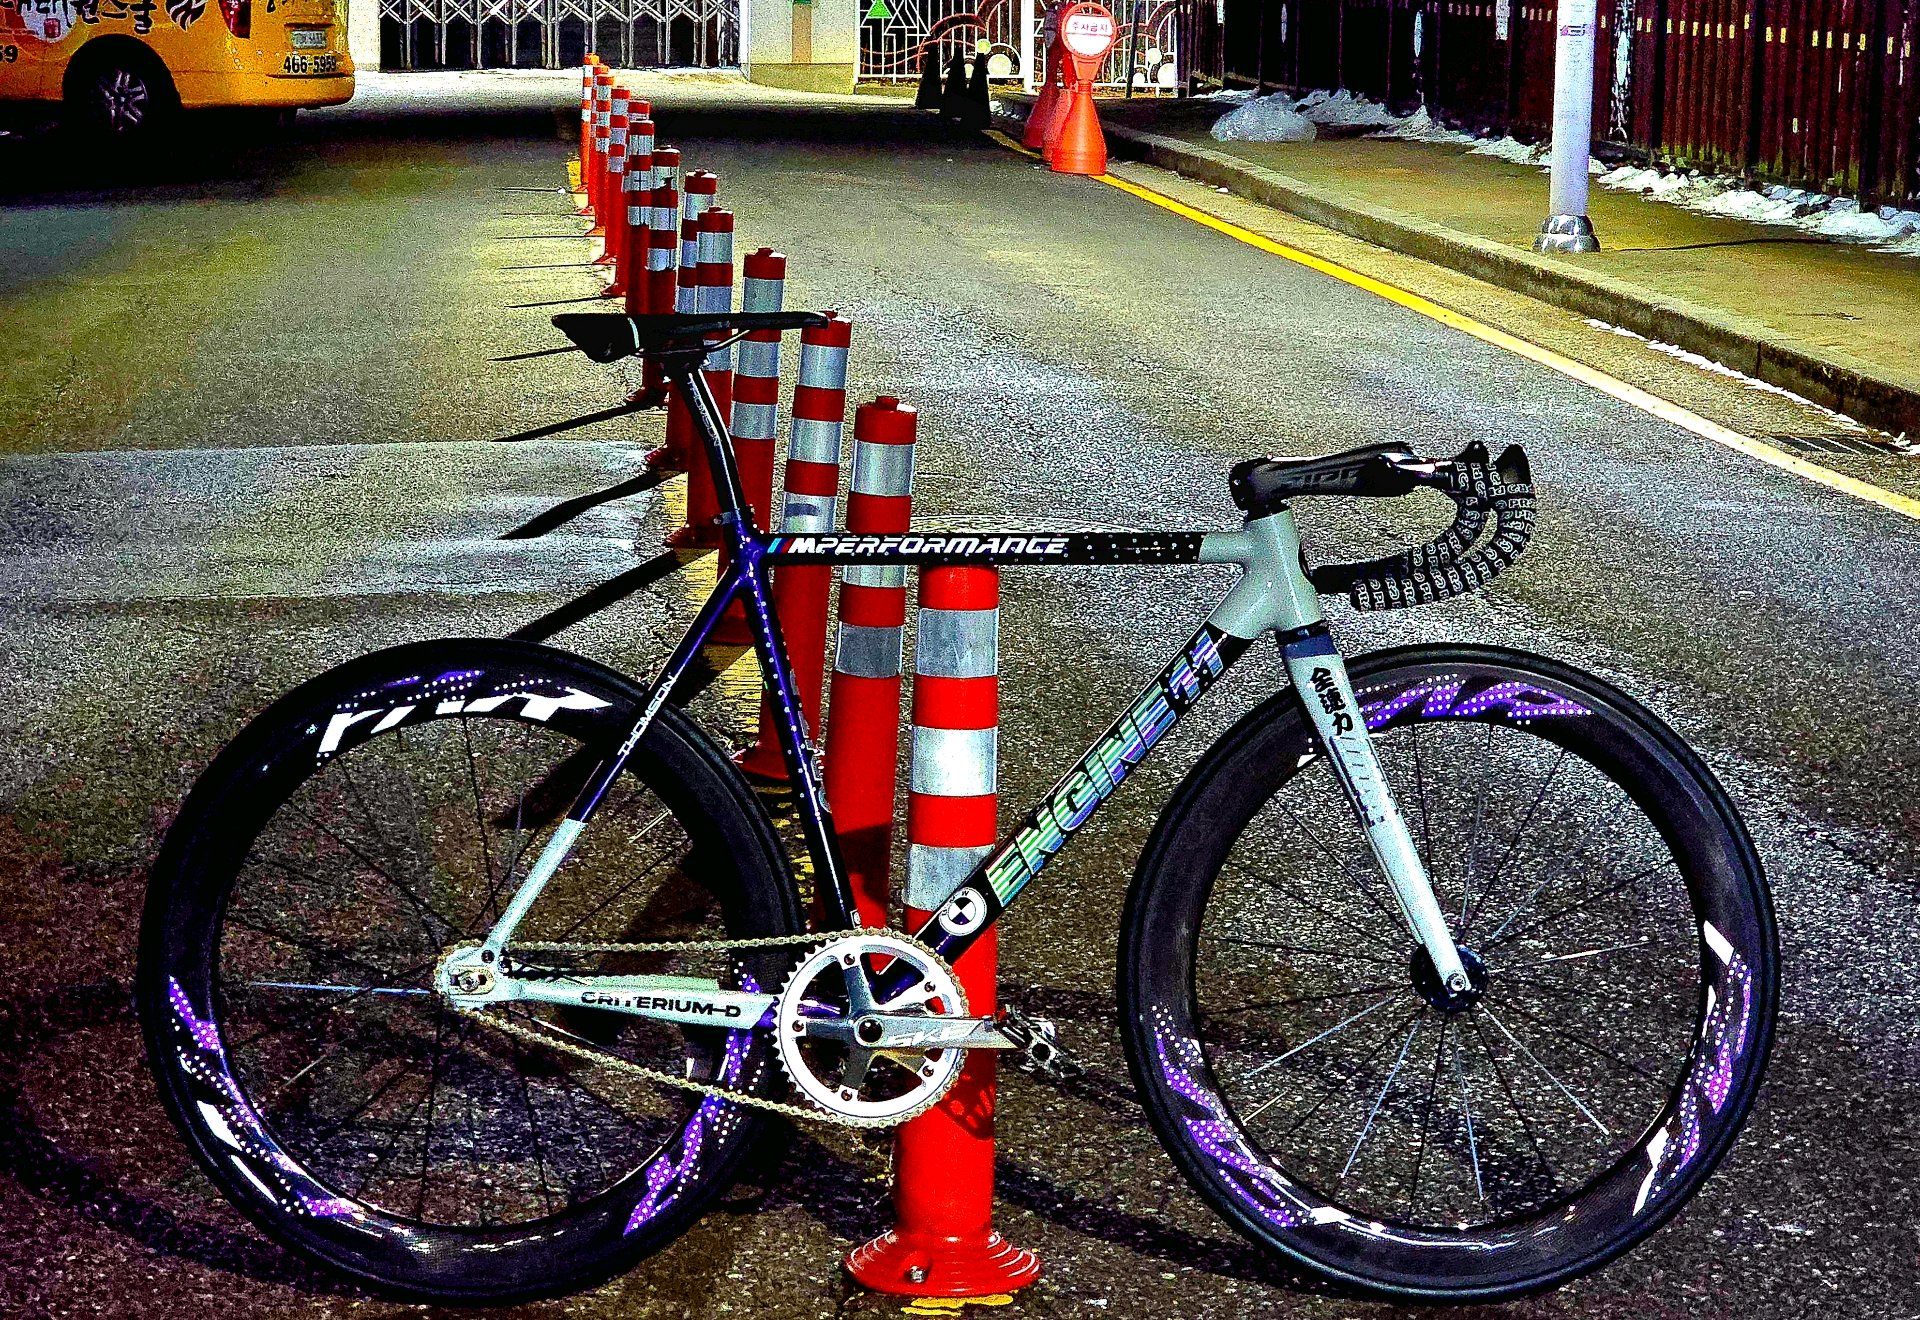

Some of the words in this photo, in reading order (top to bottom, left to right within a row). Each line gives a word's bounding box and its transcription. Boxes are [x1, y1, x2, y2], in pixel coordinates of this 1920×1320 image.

[283, 55, 337, 74] 466-5959
[617, 673, 678, 756] THOMSON
[581, 991, 742, 1018] CRITERIUM-D
